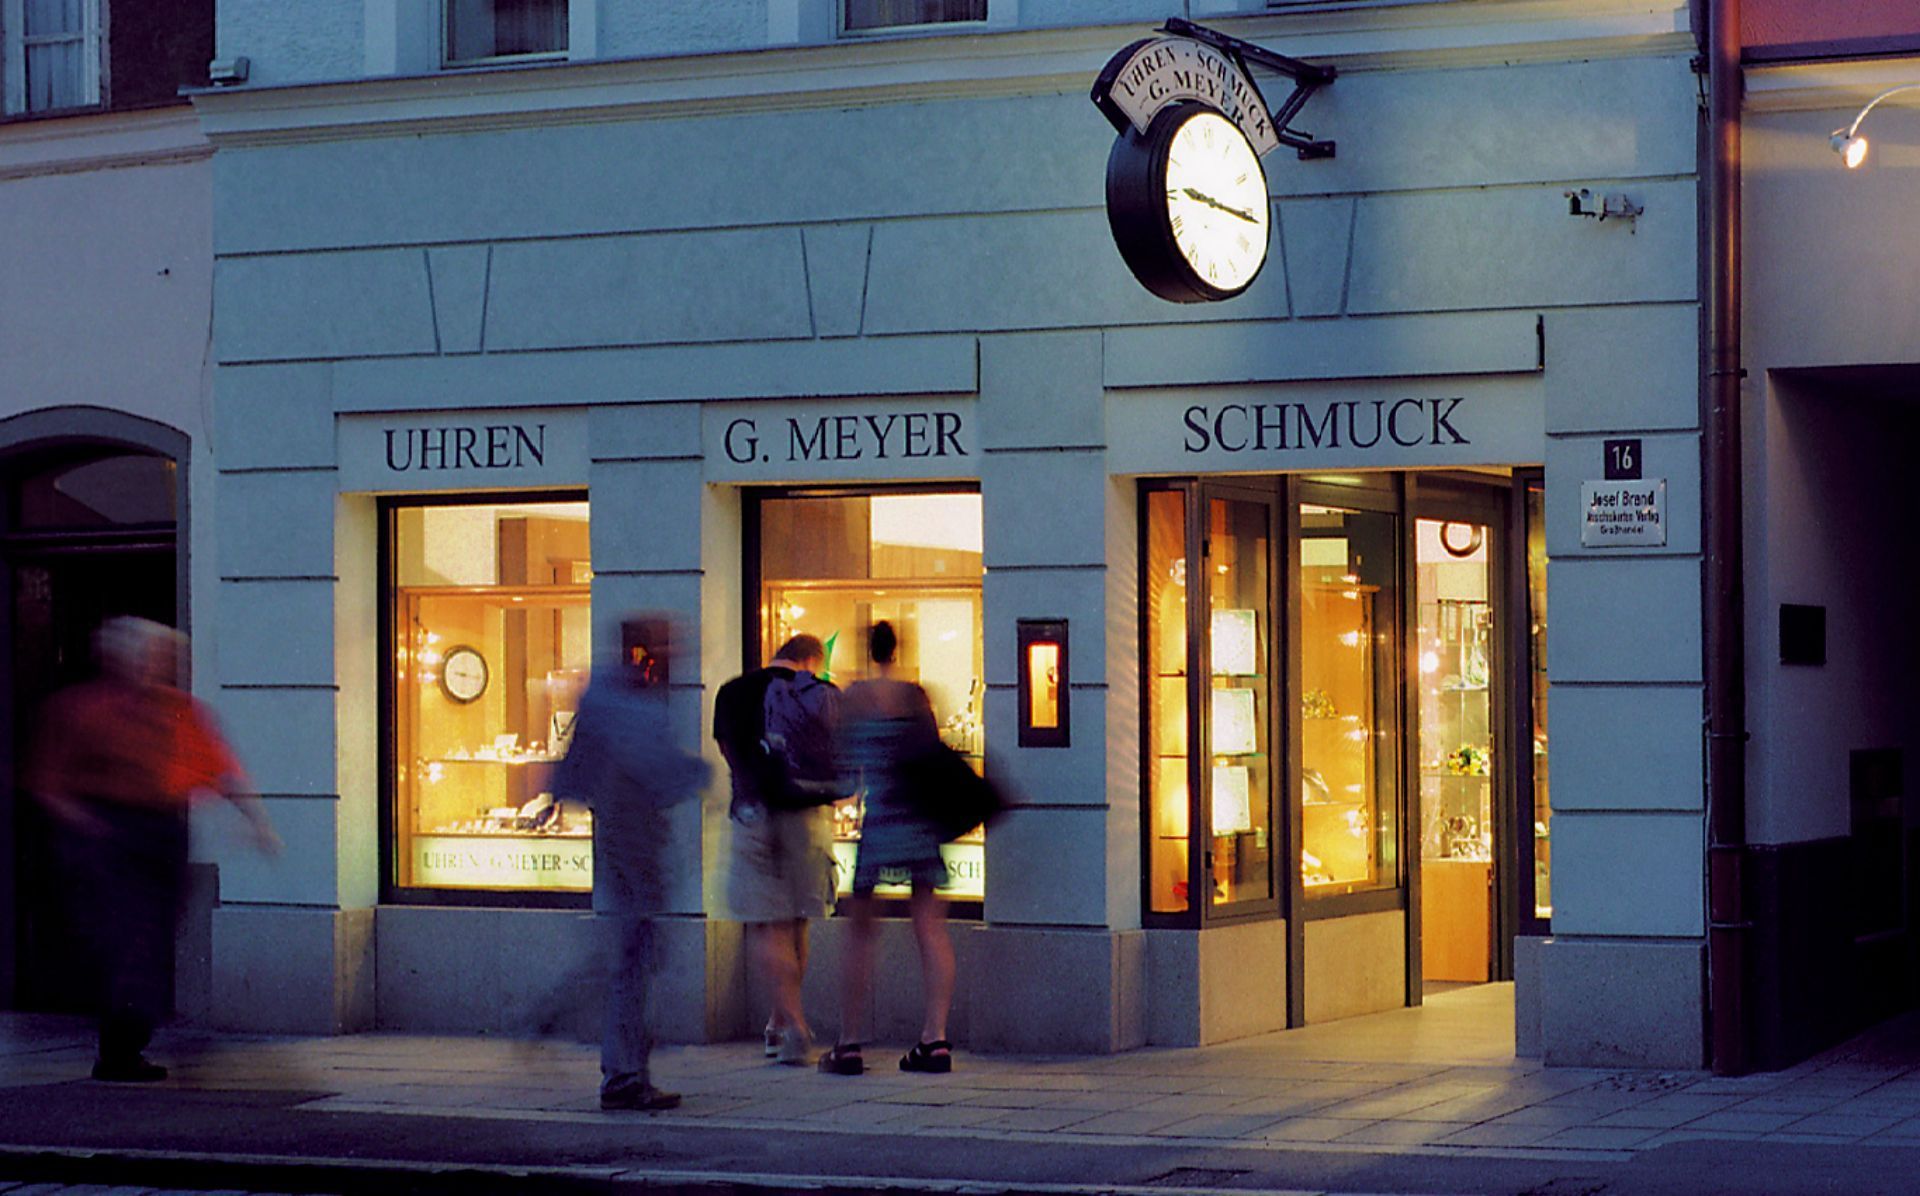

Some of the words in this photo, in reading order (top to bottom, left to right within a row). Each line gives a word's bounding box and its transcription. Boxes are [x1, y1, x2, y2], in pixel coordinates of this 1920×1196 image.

[1119, 45, 1177, 97] UHREN
[1197, 49, 1271, 138] SCHMUCK
[1149, 79, 1169, 101] G.
[1174, 70, 1244, 128] MEYER
[384, 424, 546, 472] UHREN
[724, 418, 769, 463] G.
[786, 412, 968, 462] MEYER
[1182, 397, 1471, 453] SCHMUCK
[1612, 445, 1633, 470] 16
[1590, 490, 1620, 507] Josef
[1622, 490, 1654, 507] Brand
